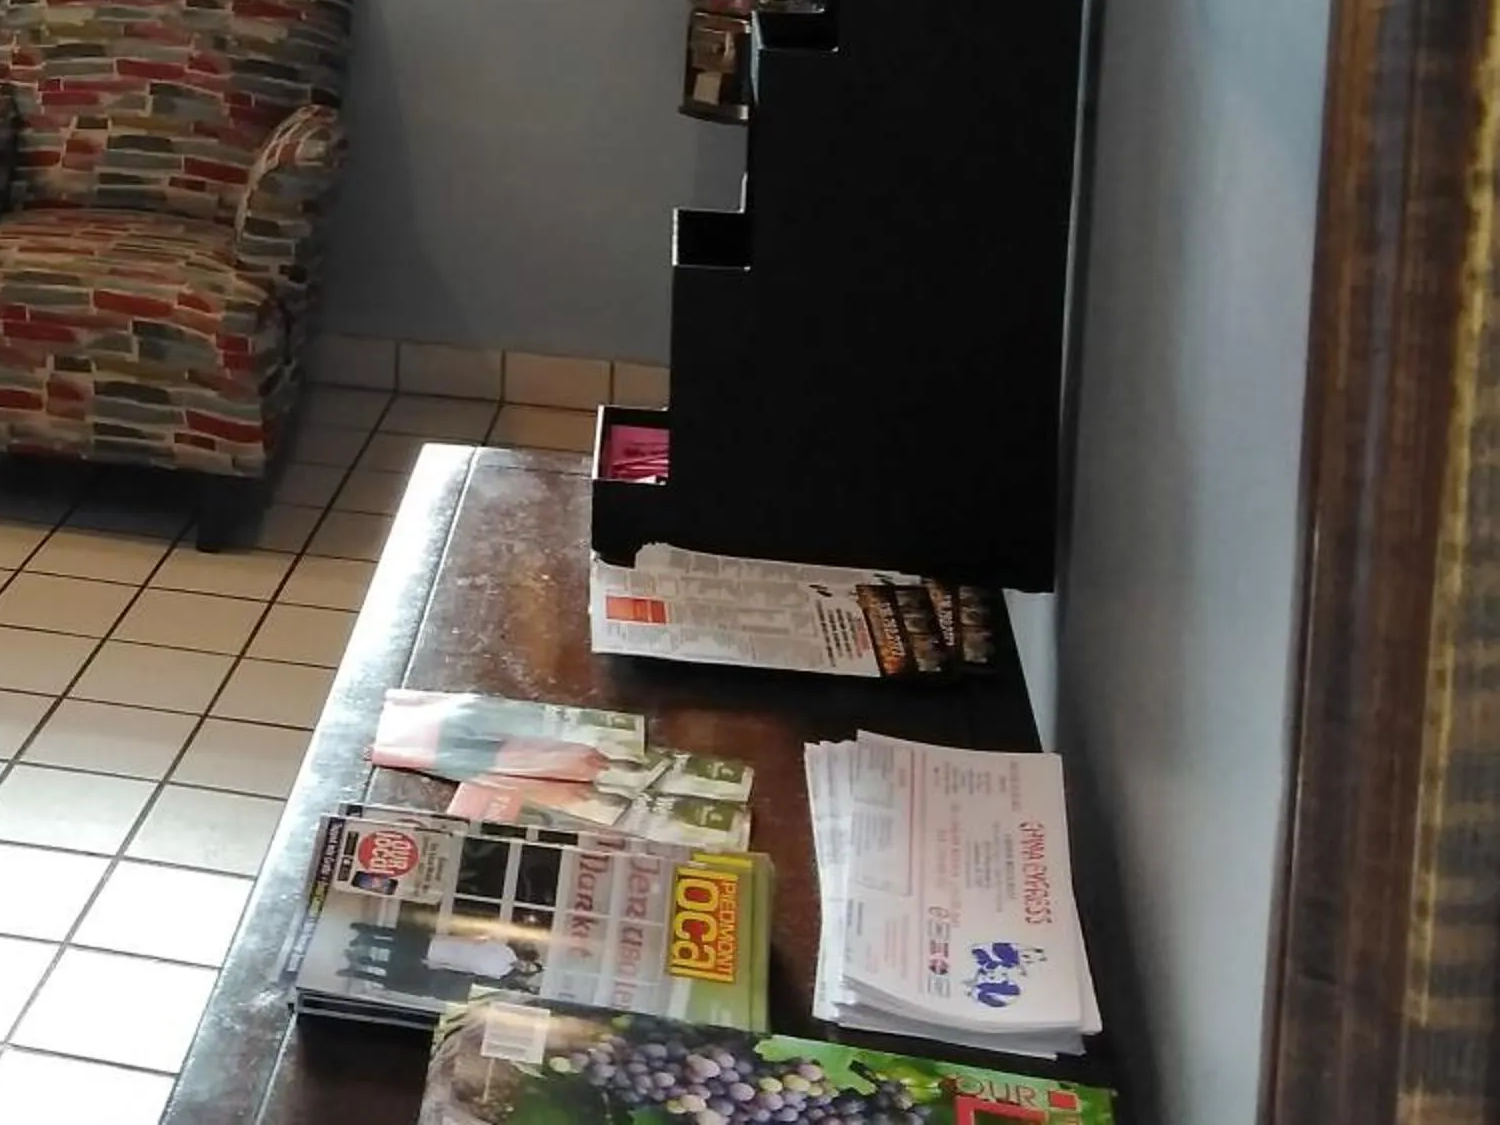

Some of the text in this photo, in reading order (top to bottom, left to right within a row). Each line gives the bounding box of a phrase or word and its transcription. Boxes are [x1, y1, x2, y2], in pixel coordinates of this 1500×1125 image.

[385, 838, 412, 869] OUR
[1020, 820, 1052, 924] CHINA EXPRESS
[716, 881, 737, 974] PIEDMONT
